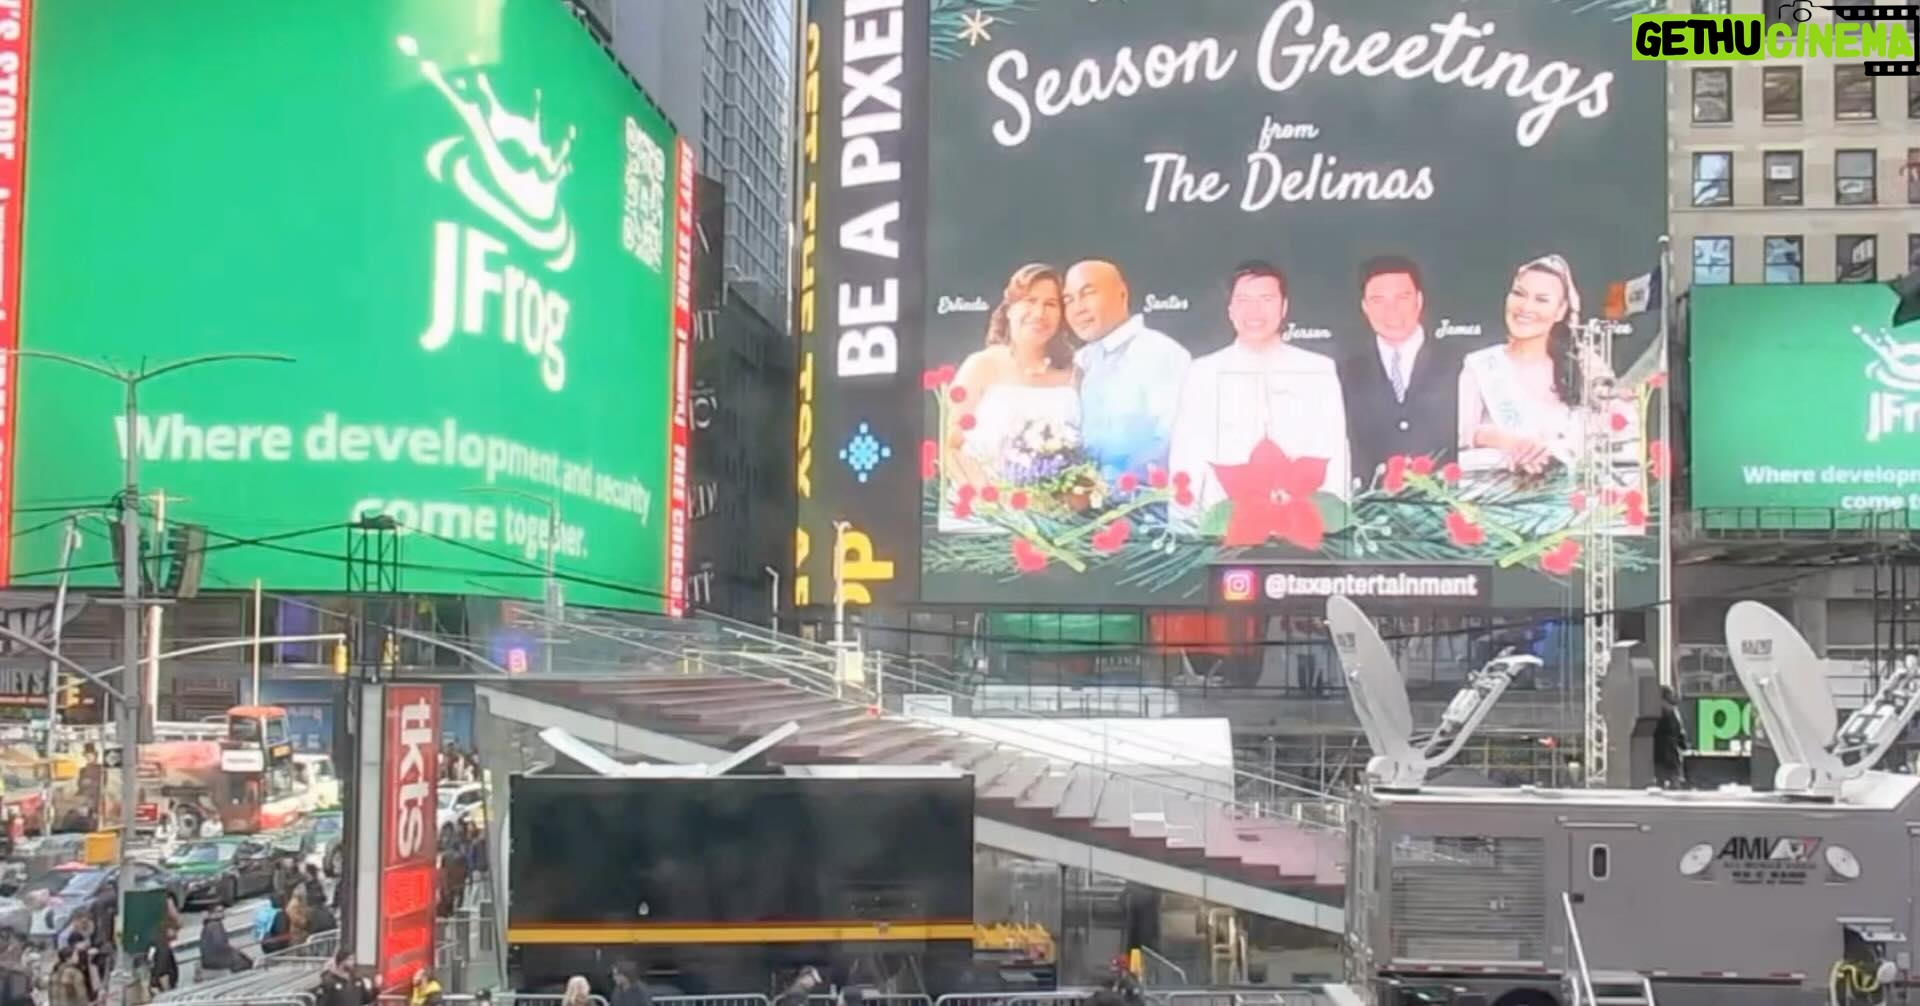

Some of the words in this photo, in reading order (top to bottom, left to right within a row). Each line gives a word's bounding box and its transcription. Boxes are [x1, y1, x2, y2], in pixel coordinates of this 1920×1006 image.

[987, 49, 1238, 147] Season
[1257, 0, 1614, 147] Greetings
[1258, 115, 1320, 152] from
[1144, 152, 1230, 213] The
[1239, 152, 1435, 212] Delimas
[840, 200, 900, 259] A
[419, 220, 571, 392] JFrog
[838, 278, 899, 377] BE
[1144, 294, 1189, 313] Santos
[1435, 318, 1482, 339] James
[114, 413, 292, 463] Where
[305, 412, 560, 487] development
[562, 459, 594, 499] and
[596, 473, 652, 529] security
[1742, 466, 1816, 484] Where
[352, 498, 498, 542] come
[1841, 495, 1905, 511] come
[399, 696, 433, 858] tkts
[1717, 836, 1780, 860] AMV
